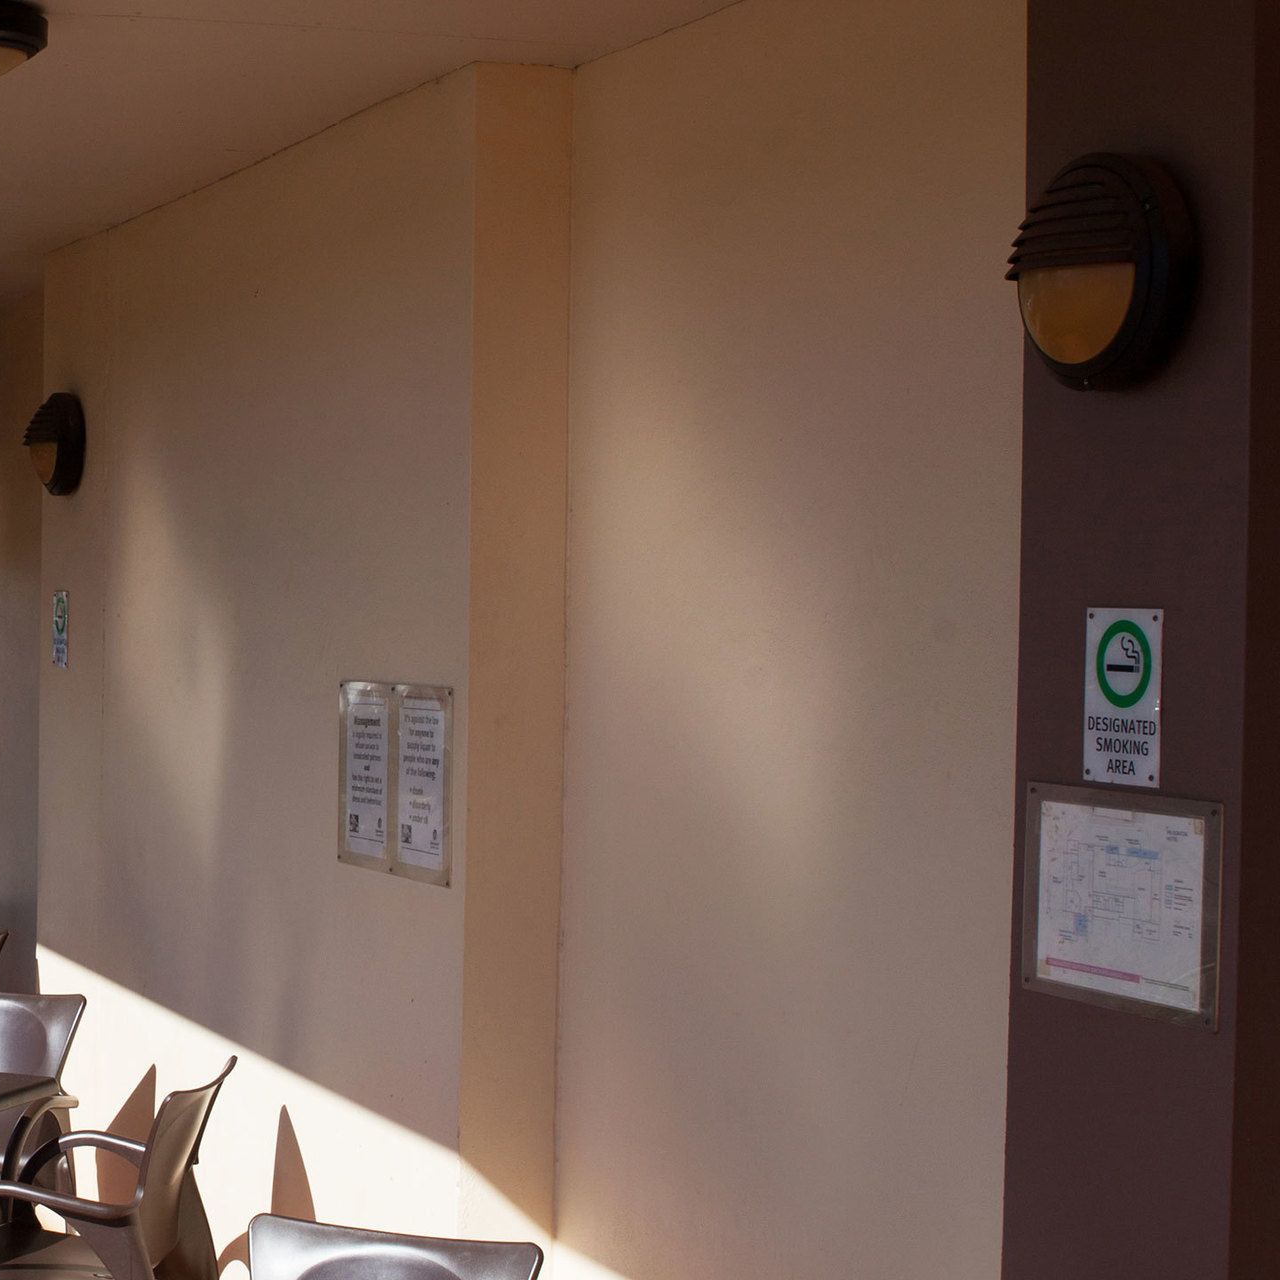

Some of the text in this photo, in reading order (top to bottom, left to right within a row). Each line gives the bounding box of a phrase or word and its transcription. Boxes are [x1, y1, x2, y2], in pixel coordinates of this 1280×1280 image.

[1088, 716, 1156, 736] DESIGNATED
[1095, 737, 1149, 756] SMOKING
[1106, 758, 1136, 776] AREA
